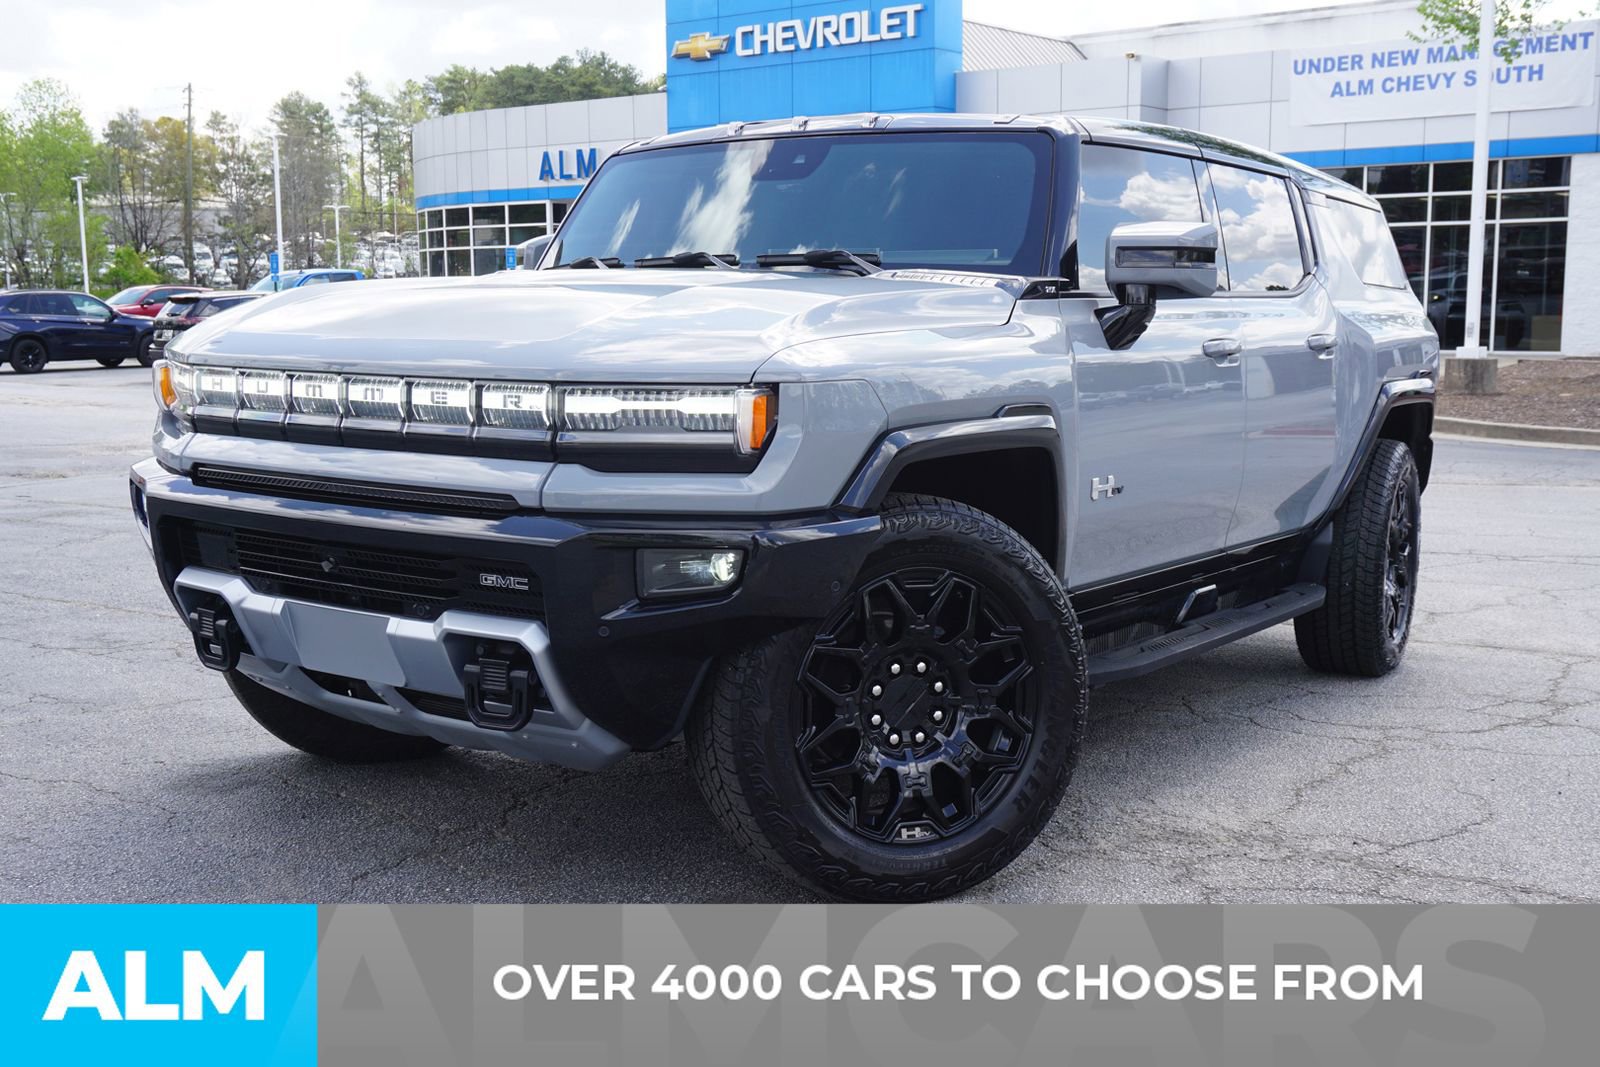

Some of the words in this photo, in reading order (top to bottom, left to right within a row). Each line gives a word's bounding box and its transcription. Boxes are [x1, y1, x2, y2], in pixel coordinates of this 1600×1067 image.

[735, 3, 924, 57] CHEVROLET
[1293, 55, 1364, 76] UNDER
[1371, 49, 1420, 70] NEW
[1426, 31, 1595, 64] MANGEMENT
[1330, 79, 1374, 98] ALM
[1381, 71, 1456, 94] CHEVY
[1463, 64, 1545, 88] SUTH
[539, 148, 597, 180] ALM
[480, 573, 529, 590] GMC
